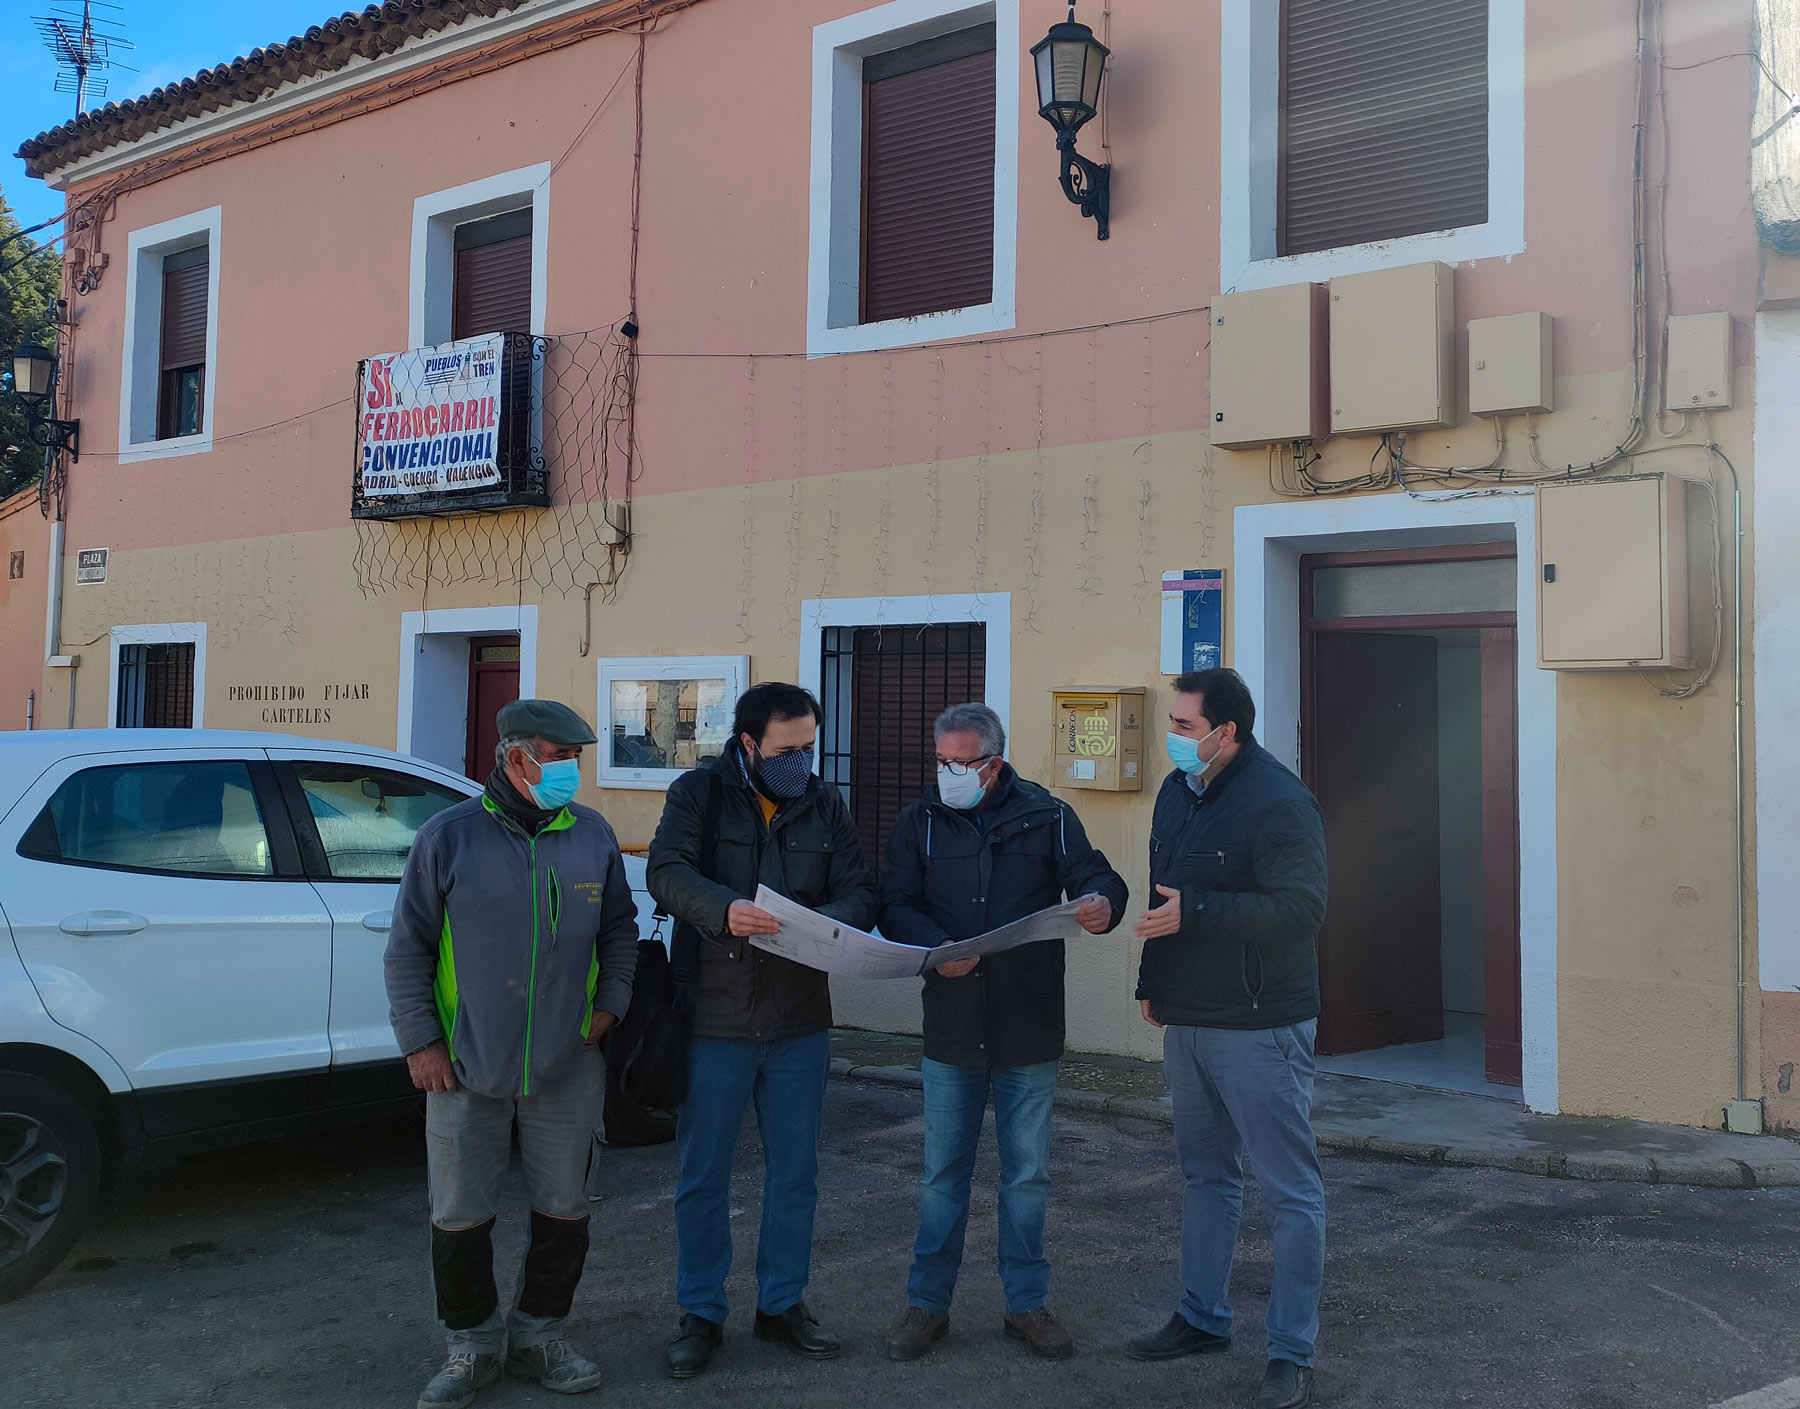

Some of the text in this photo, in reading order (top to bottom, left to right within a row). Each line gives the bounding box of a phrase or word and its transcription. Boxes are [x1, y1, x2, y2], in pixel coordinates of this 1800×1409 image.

[424, 353, 462, 373] PUEBLOS
[472, 349, 495, 362] CON EL
[472, 363, 495, 378] TREN
[367, 356, 395, 409] SÍ
[363, 396, 496, 442] FERROCARRIL
[363, 432, 492, 472] CONVENCIONAL
[364, 474, 397, 489] ADRID
[403, 469, 438, 487] CUENCA
[446, 463, 495, 482] VALENCIA
[83, 553, 102, 564] PLAZA
[229, 683, 370, 701] PROHIBIDO FIJAR
[262, 707, 332, 724] CARTELES
[1067, 709, 1077, 753] CORREOS
